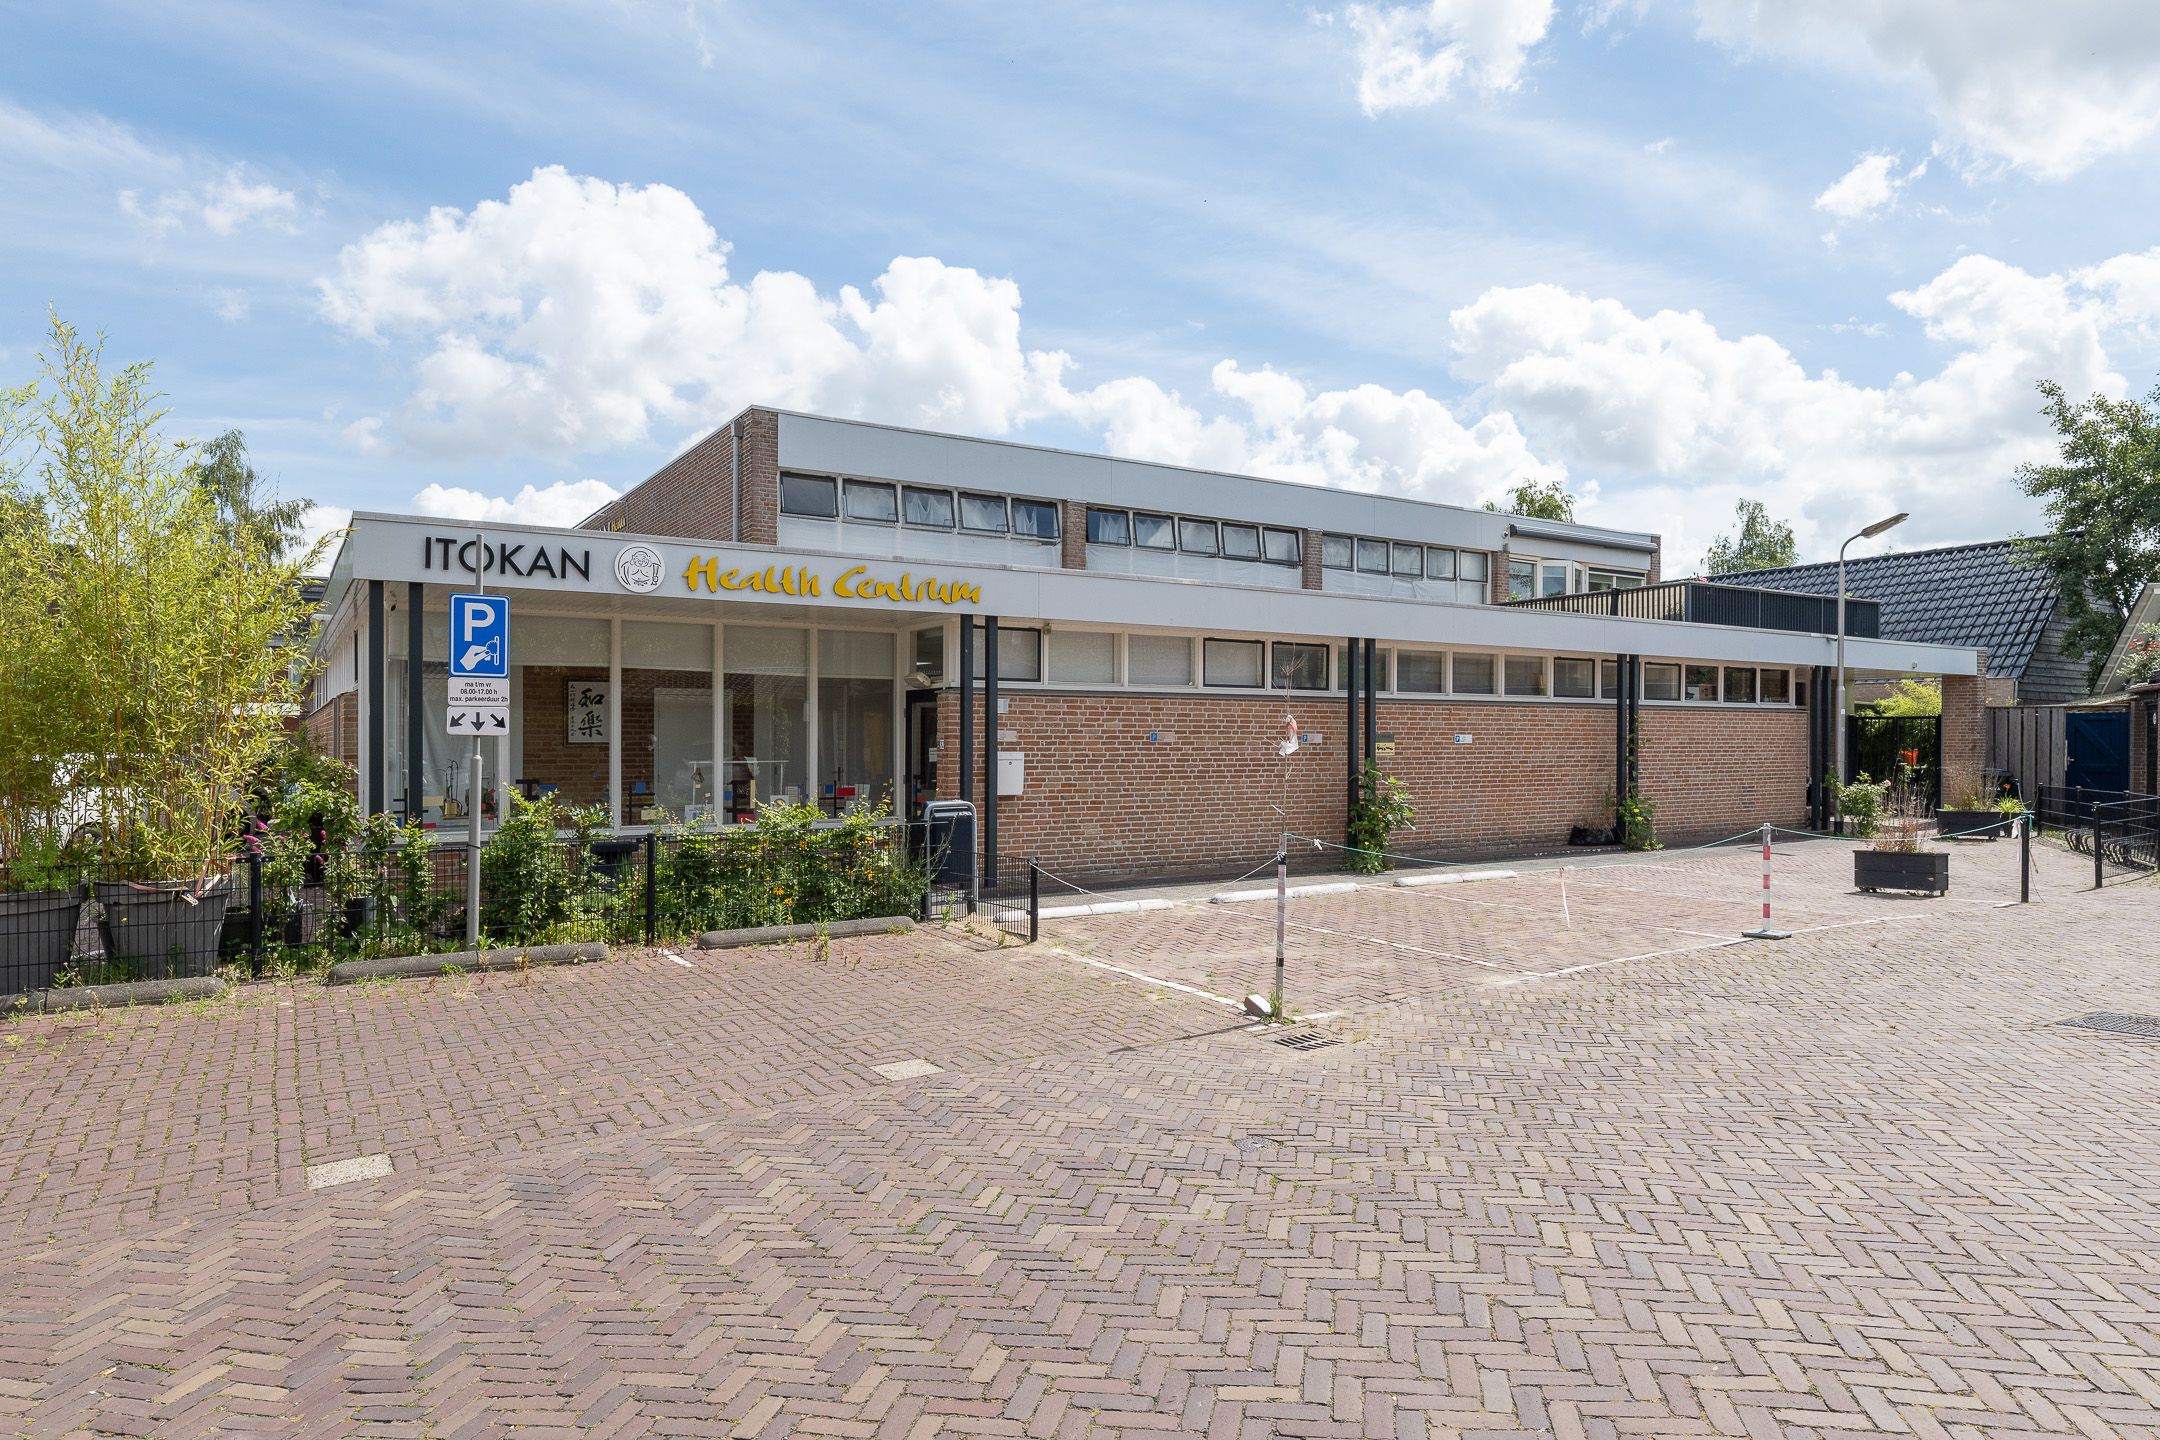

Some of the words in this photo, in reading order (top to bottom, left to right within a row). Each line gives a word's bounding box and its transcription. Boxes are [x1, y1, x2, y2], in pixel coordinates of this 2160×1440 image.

[424, 536, 590, 583] ITOKAN
[682, 555, 822, 597] Health
[833, 564, 982, 605] Centrum
[464, 602, 496, 642] P
[464, 695, 500, 703] parkeerduur
